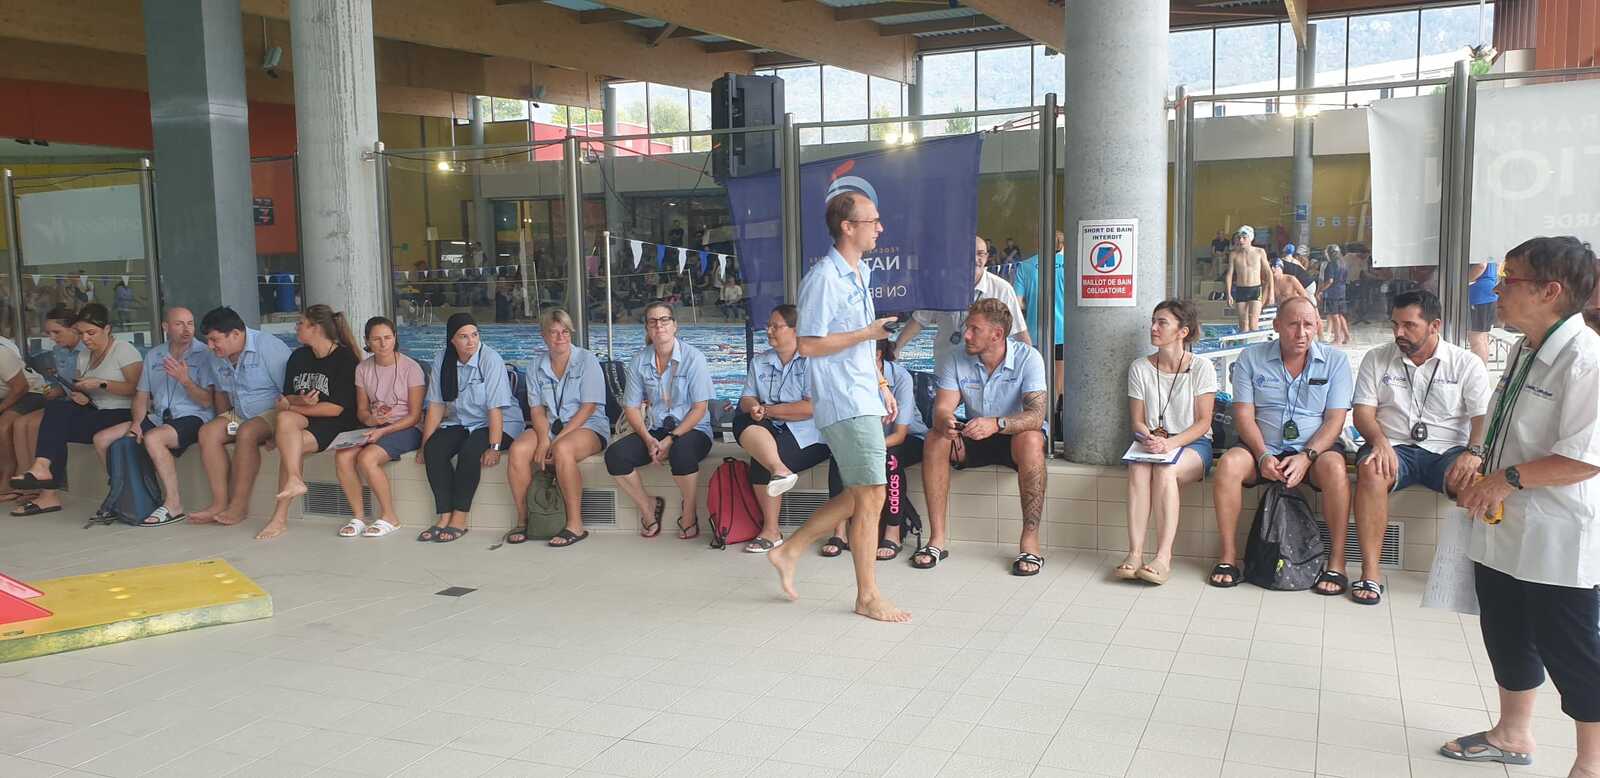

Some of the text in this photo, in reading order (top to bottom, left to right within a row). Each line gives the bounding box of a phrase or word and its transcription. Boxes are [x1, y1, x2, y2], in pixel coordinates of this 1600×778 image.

[1082, 278, 1107, 286] MAILLOT
[1107, 278, 1116, 286] DE
[889, 474, 900, 514] adidas
